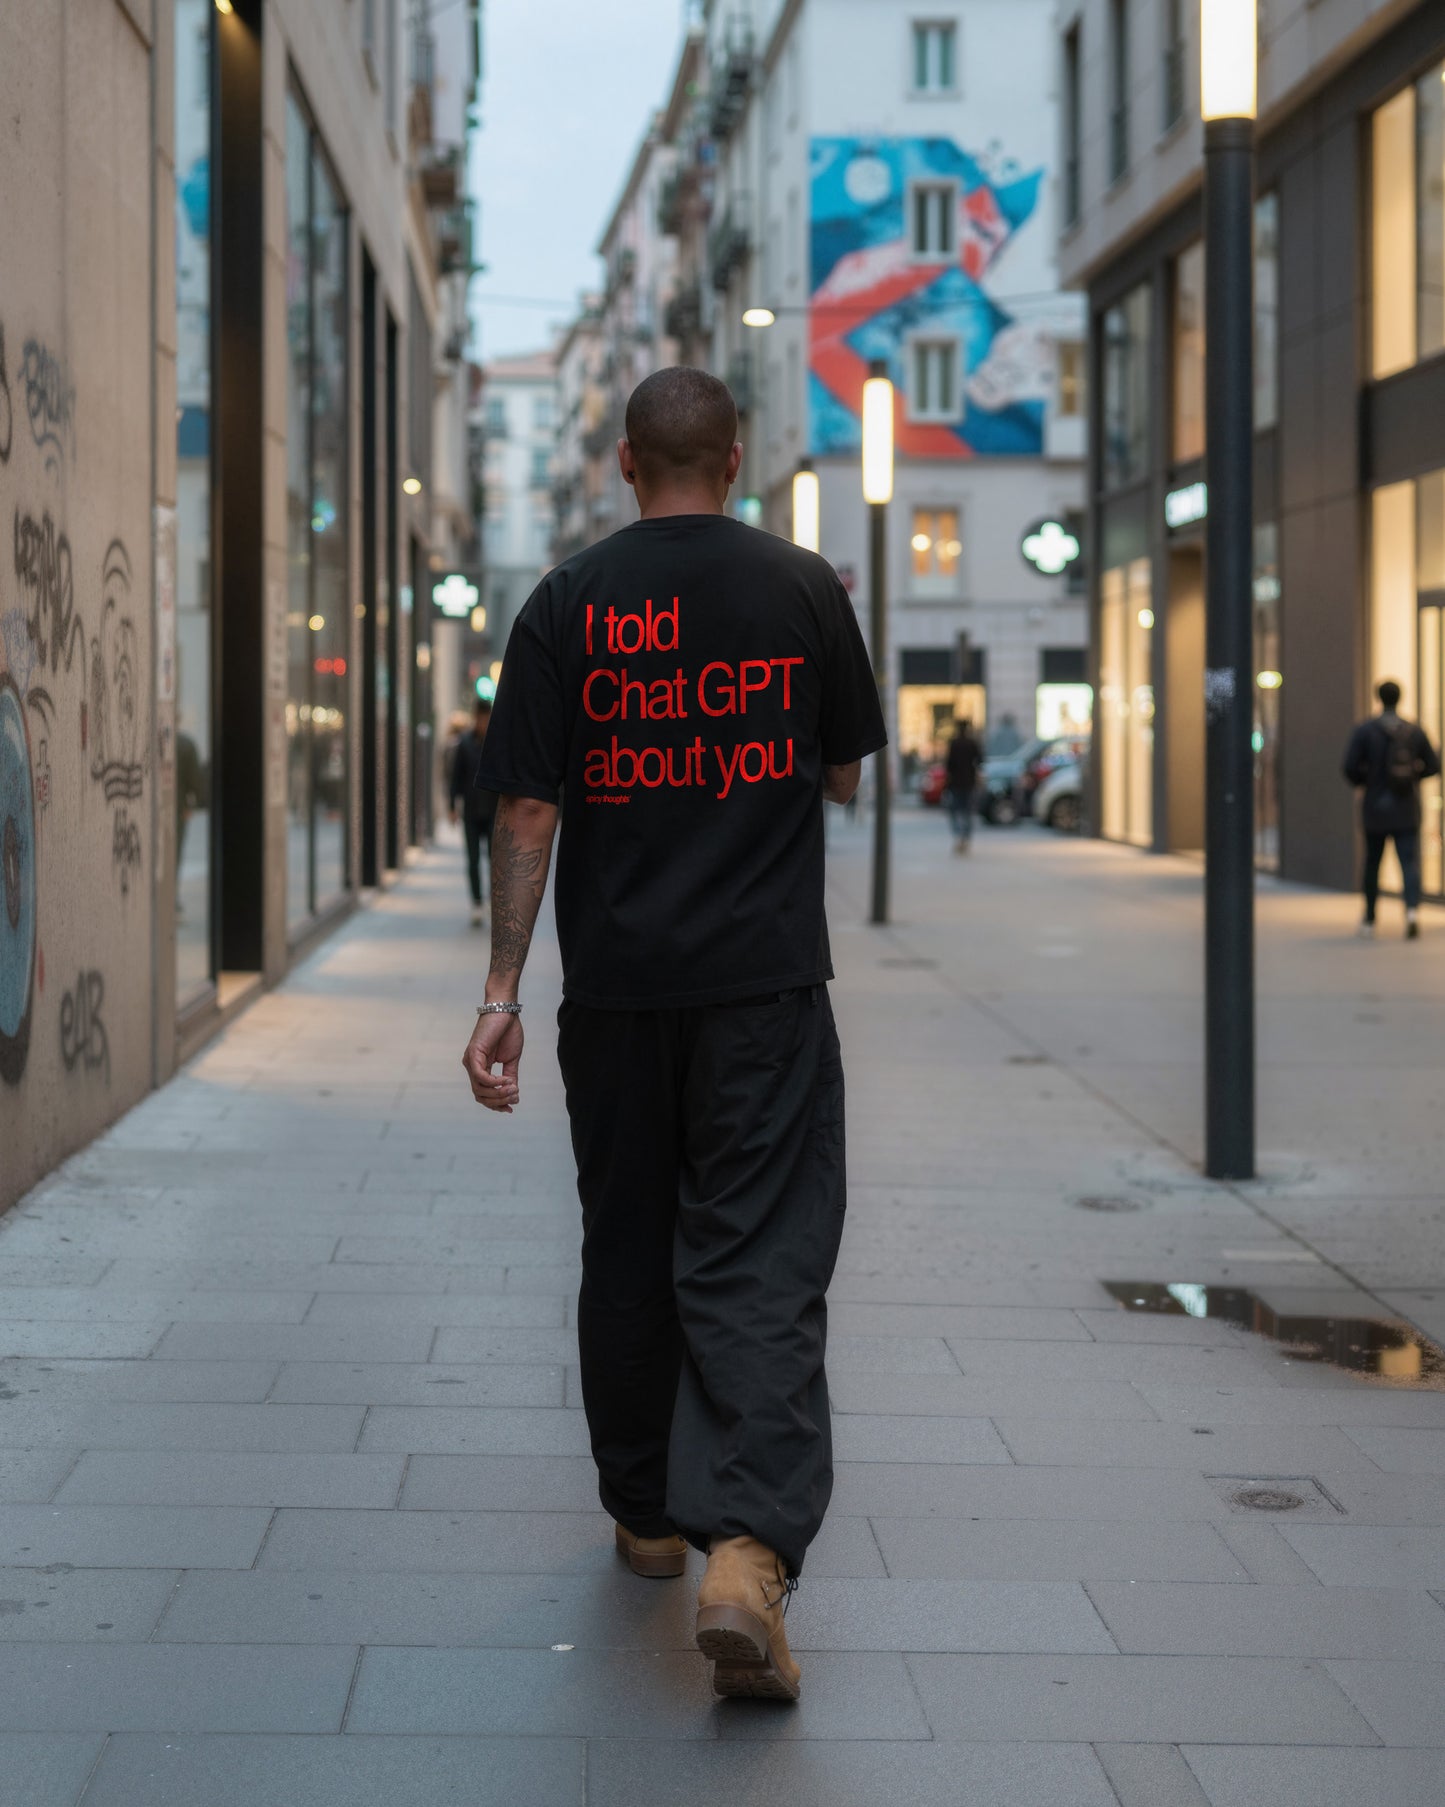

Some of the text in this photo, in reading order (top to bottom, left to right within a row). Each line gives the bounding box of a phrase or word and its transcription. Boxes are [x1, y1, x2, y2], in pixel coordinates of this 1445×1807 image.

[585, 596, 679, 655] I told
[582, 656, 805, 722] Chat GPT
[583, 735, 794, 800] about you
